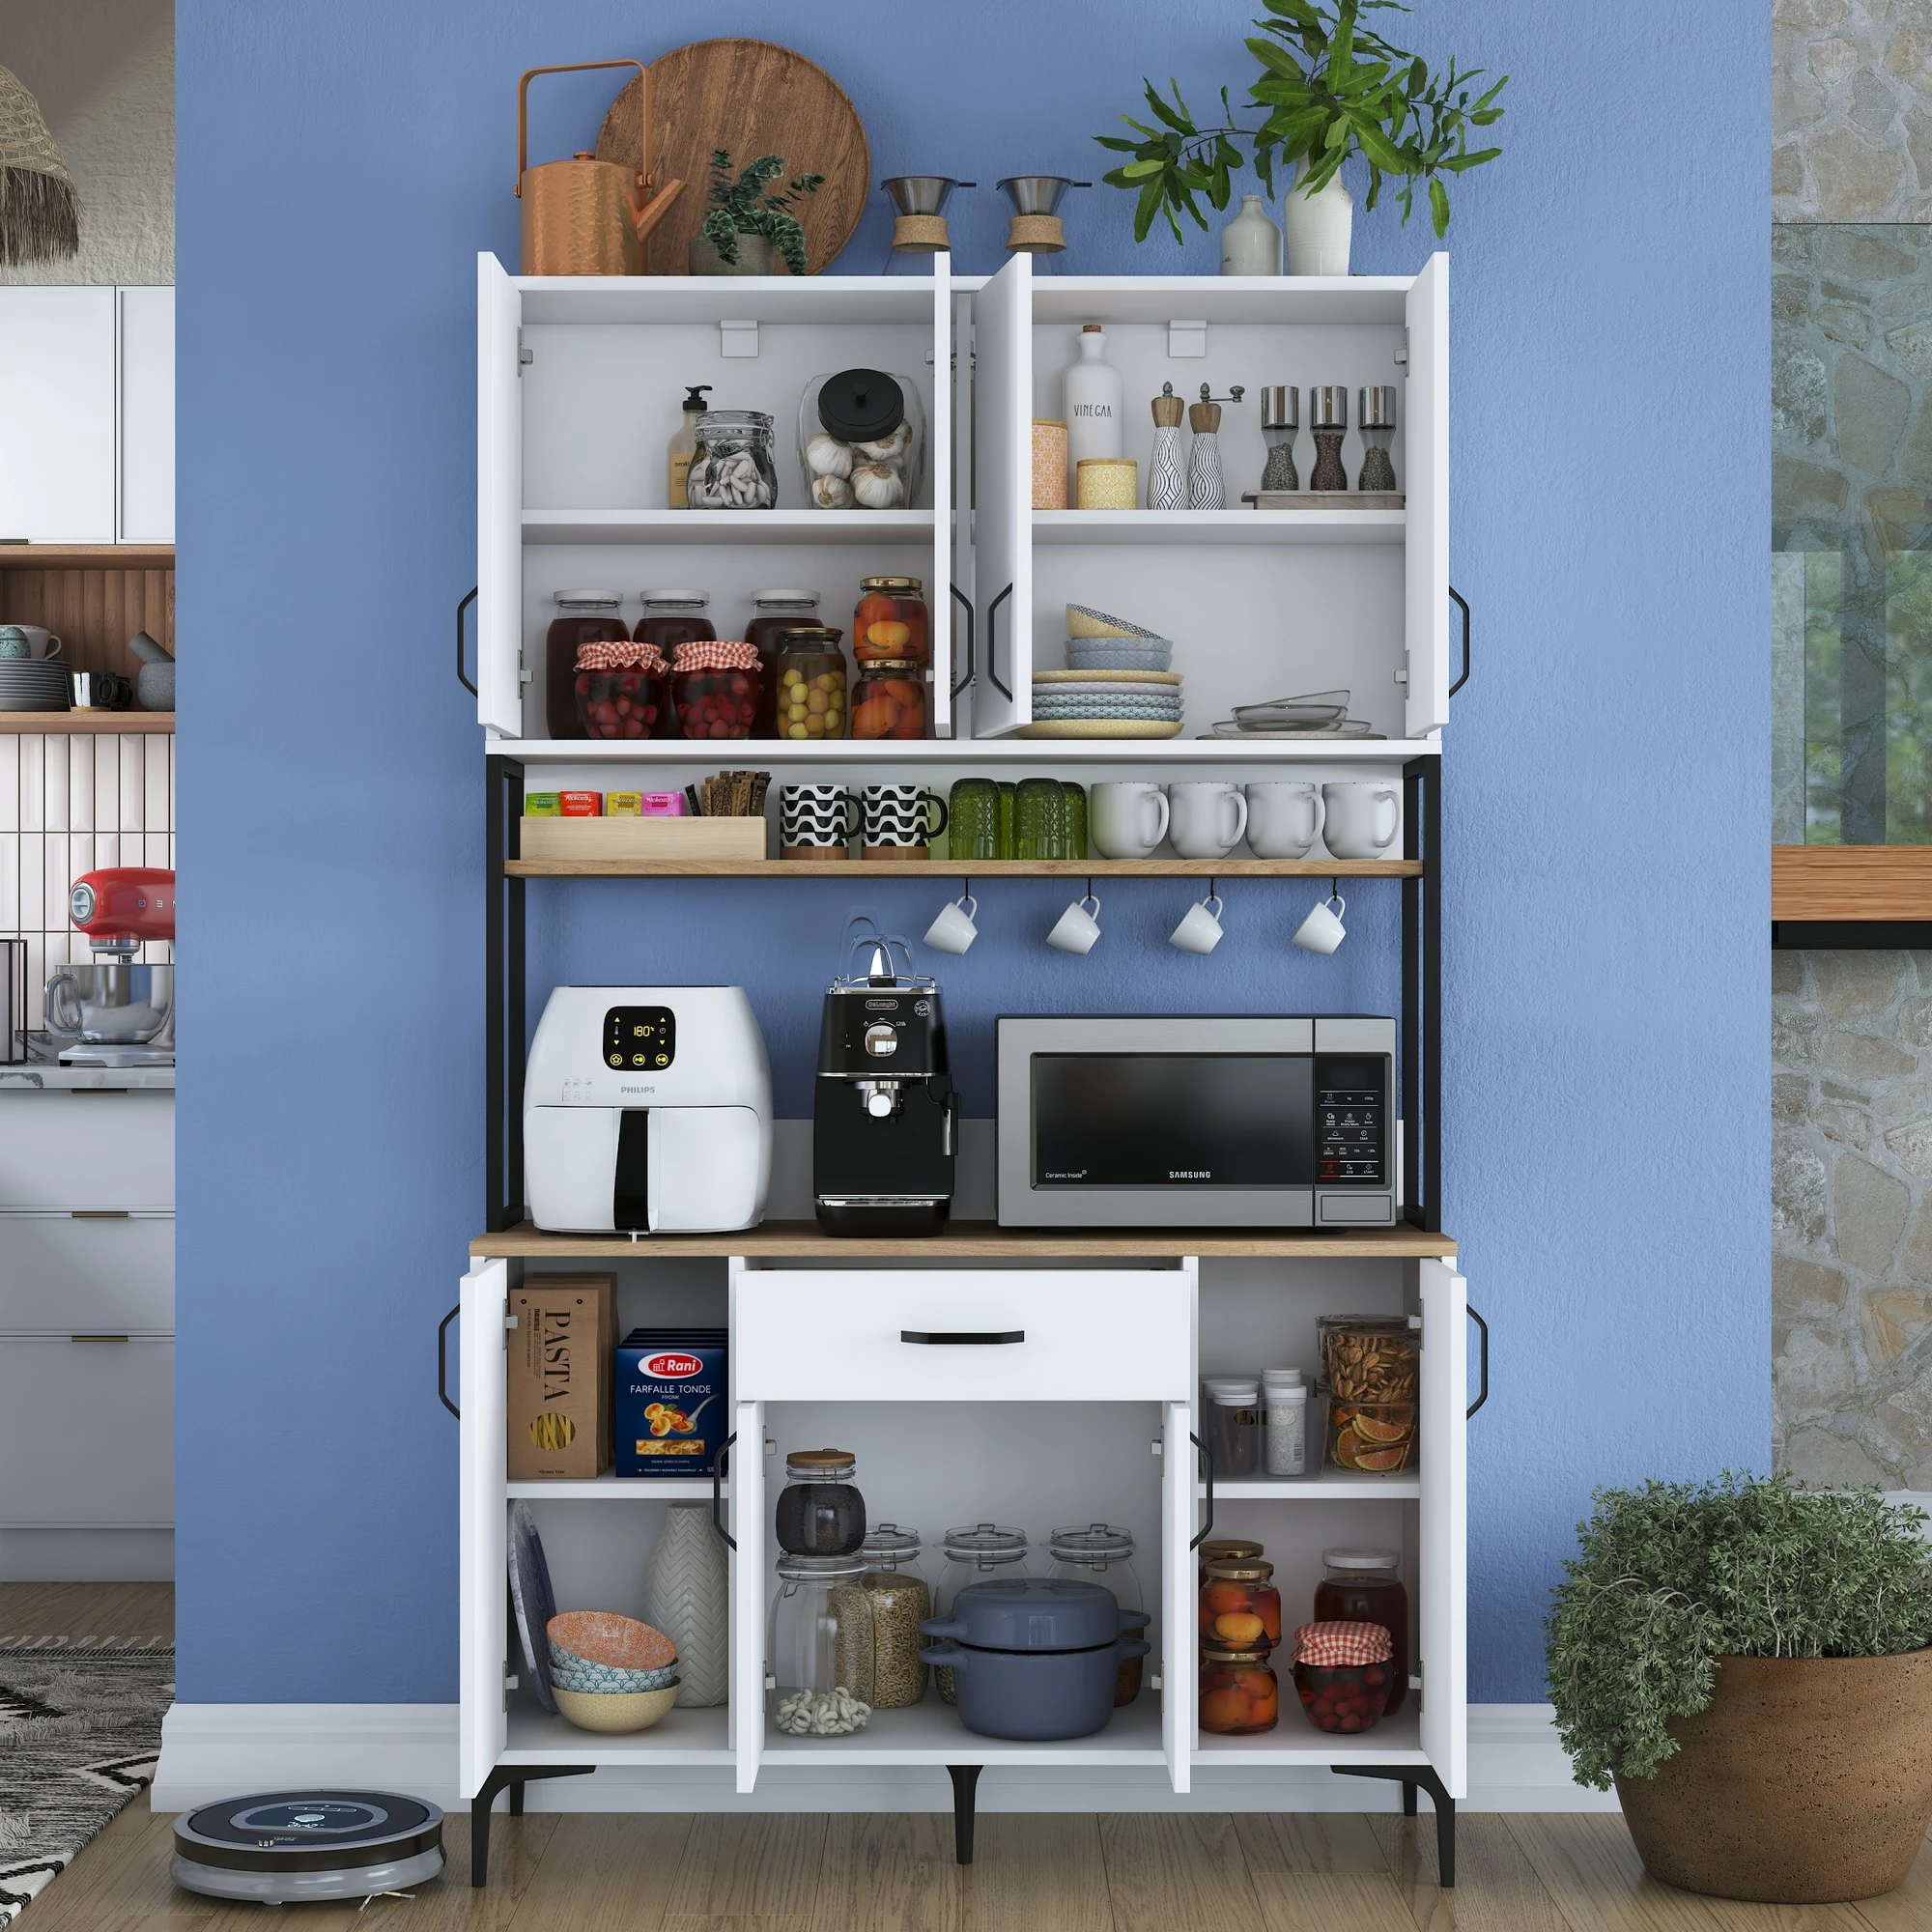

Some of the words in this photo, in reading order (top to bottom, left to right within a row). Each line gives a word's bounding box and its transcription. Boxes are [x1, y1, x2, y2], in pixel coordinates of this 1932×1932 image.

[1073, 404, 1112, 417] VINEGAR
[544, 1308, 571, 1403] PASTA
[667, 1359, 696, 1372] Rani
[630, 1384, 675, 1394] FARFALLE
[678, 1384, 711, 1394] TONDE
